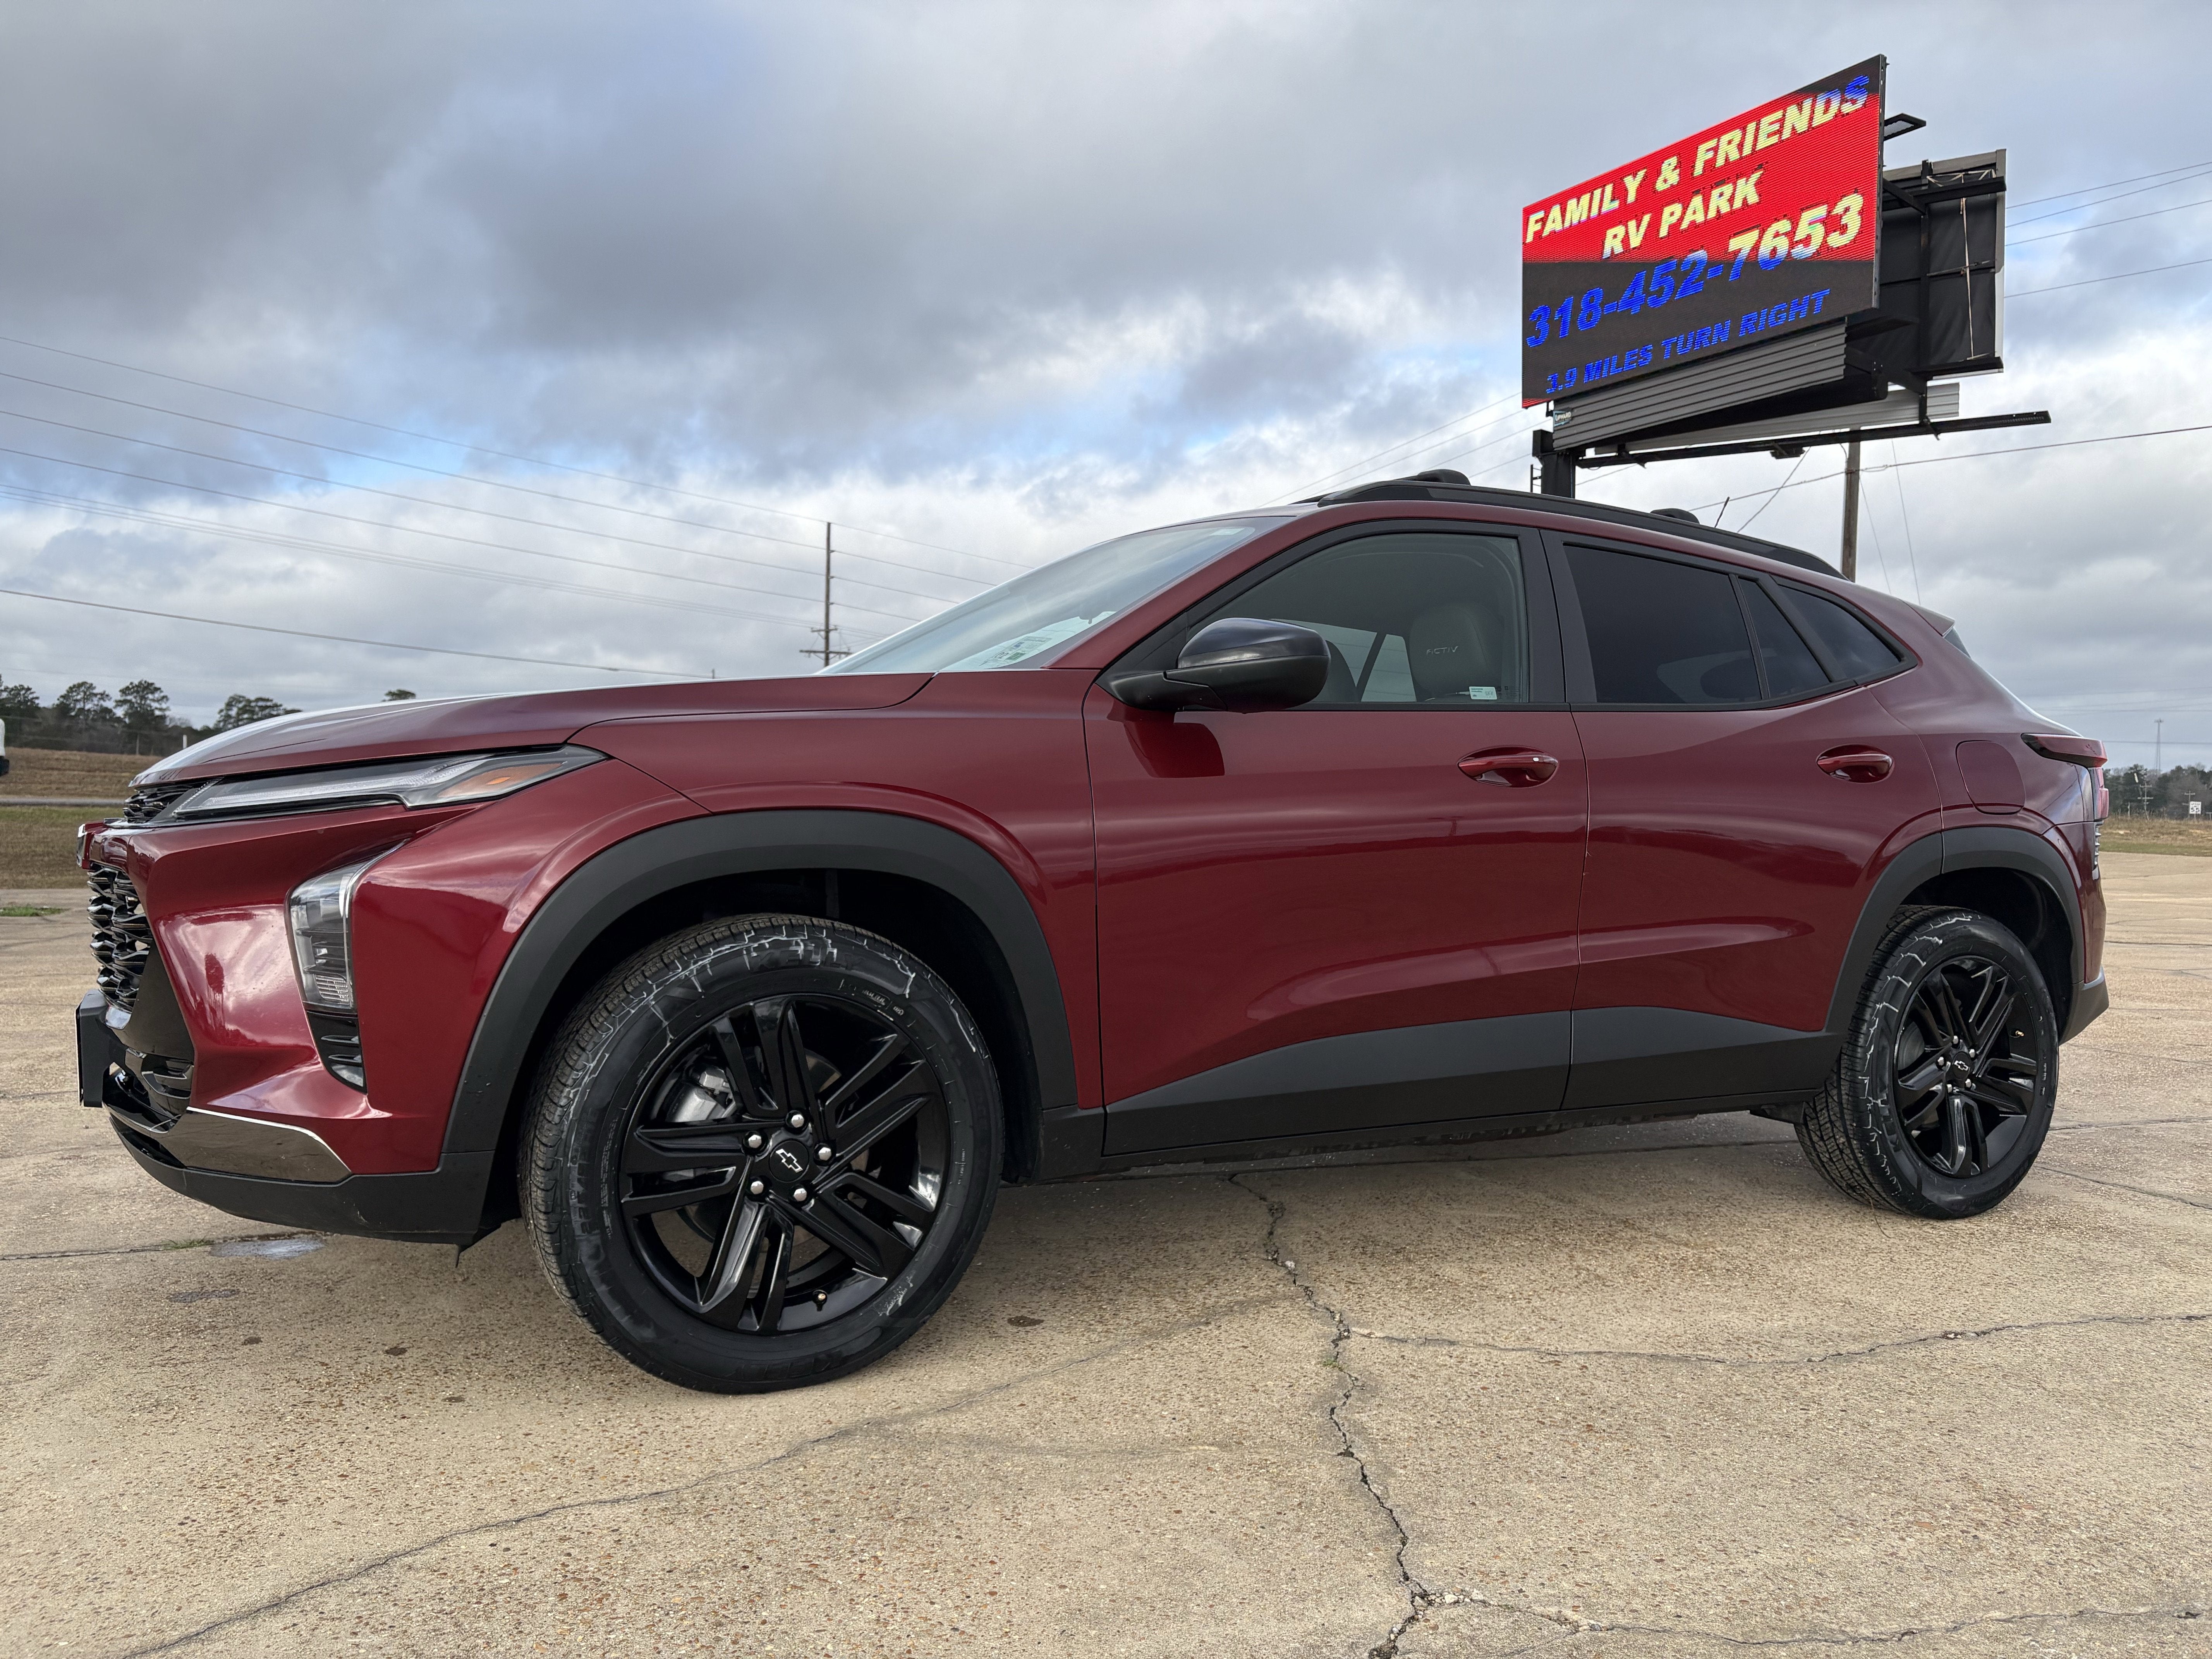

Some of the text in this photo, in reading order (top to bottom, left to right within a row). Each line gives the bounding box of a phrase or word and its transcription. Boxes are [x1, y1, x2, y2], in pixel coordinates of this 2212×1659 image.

[1526, 75, 1869, 243] FAMILY & FRIENDS
[1602, 170, 1764, 259] RV PARK
[1526, 193, 1863, 347] 318-452-7653
[1583, 344, 1653, 383] MILES
[1661, 320, 1731, 359] TURN
[1739, 289, 1830, 337] RIGHT
